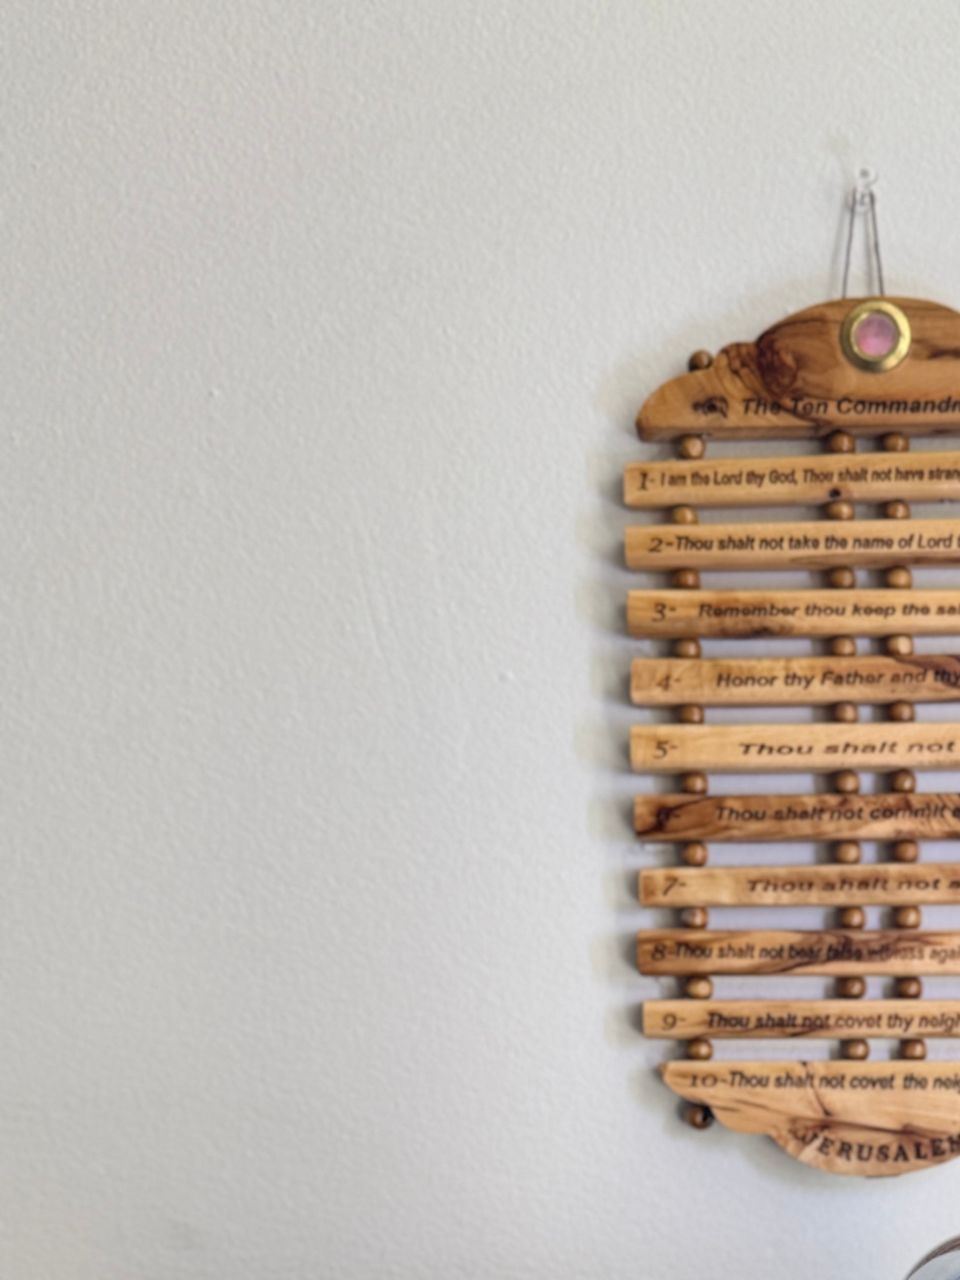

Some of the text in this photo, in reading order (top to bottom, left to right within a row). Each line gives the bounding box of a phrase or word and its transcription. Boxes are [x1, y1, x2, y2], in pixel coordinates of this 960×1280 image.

[742, 397, 780, 415] The
[790, 397, 828, 415] Ten
[668, 475, 687, 485] am
[691, 472, 710, 485] the
[713, 471, 743, 485] Lord
[746, 471, 765, 487] thy
[803, 470, 836, 483] Thou
[838, 469, 869, 483] shalt
[871, 469, 892, 481] not
[718, 535, 755, 550] shalt
[760, 536, 783, 550] not
[789, 535, 820, 549] take
[824, 535, 848, 549] the
[852, 537, 893, 549] name
[898, 534, 914, 549] of
[918, 533, 951, 549] Lord
[698, 603, 800, 618] Remember
[804, 603, 847, 616] thou
[852, 603, 896, 619] keep
[902, 604, 931, 616] the
[716, 673, 777, 687] Honor
[783, 672, 815, 689] thy
[820, 670, 885, 685] Father
[890, 668, 927, 682] and
[739, 743, 813, 755] Thou
[823, 740, 898, 755] shalt
[907, 741, 956, 754] not
[715, 806, 767, 820] Thou
[773, 806, 823, 820] shalt
[829, 807, 863, 820] not
[747, 879, 814, 891] Thou
[821, 876, 889, 891] shalt
[896, 877, 941, 889] not
[718, 943, 755, 959] shalt
[759, 945, 783, 959] not
[707, 1012, 750, 1028] Thou
[755, 1014, 798, 1029] shalt
[802, 1015, 830, 1029] not
[834, 1016, 881, 1028] covet
[887, 1013, 914, 1032] thy
[774, 1072, 814, 1088] shalt
[819, 1074, 845, 1089] not
[849, 1075, 895, 1089] covet
[903, 1074, 928, 1089] the
